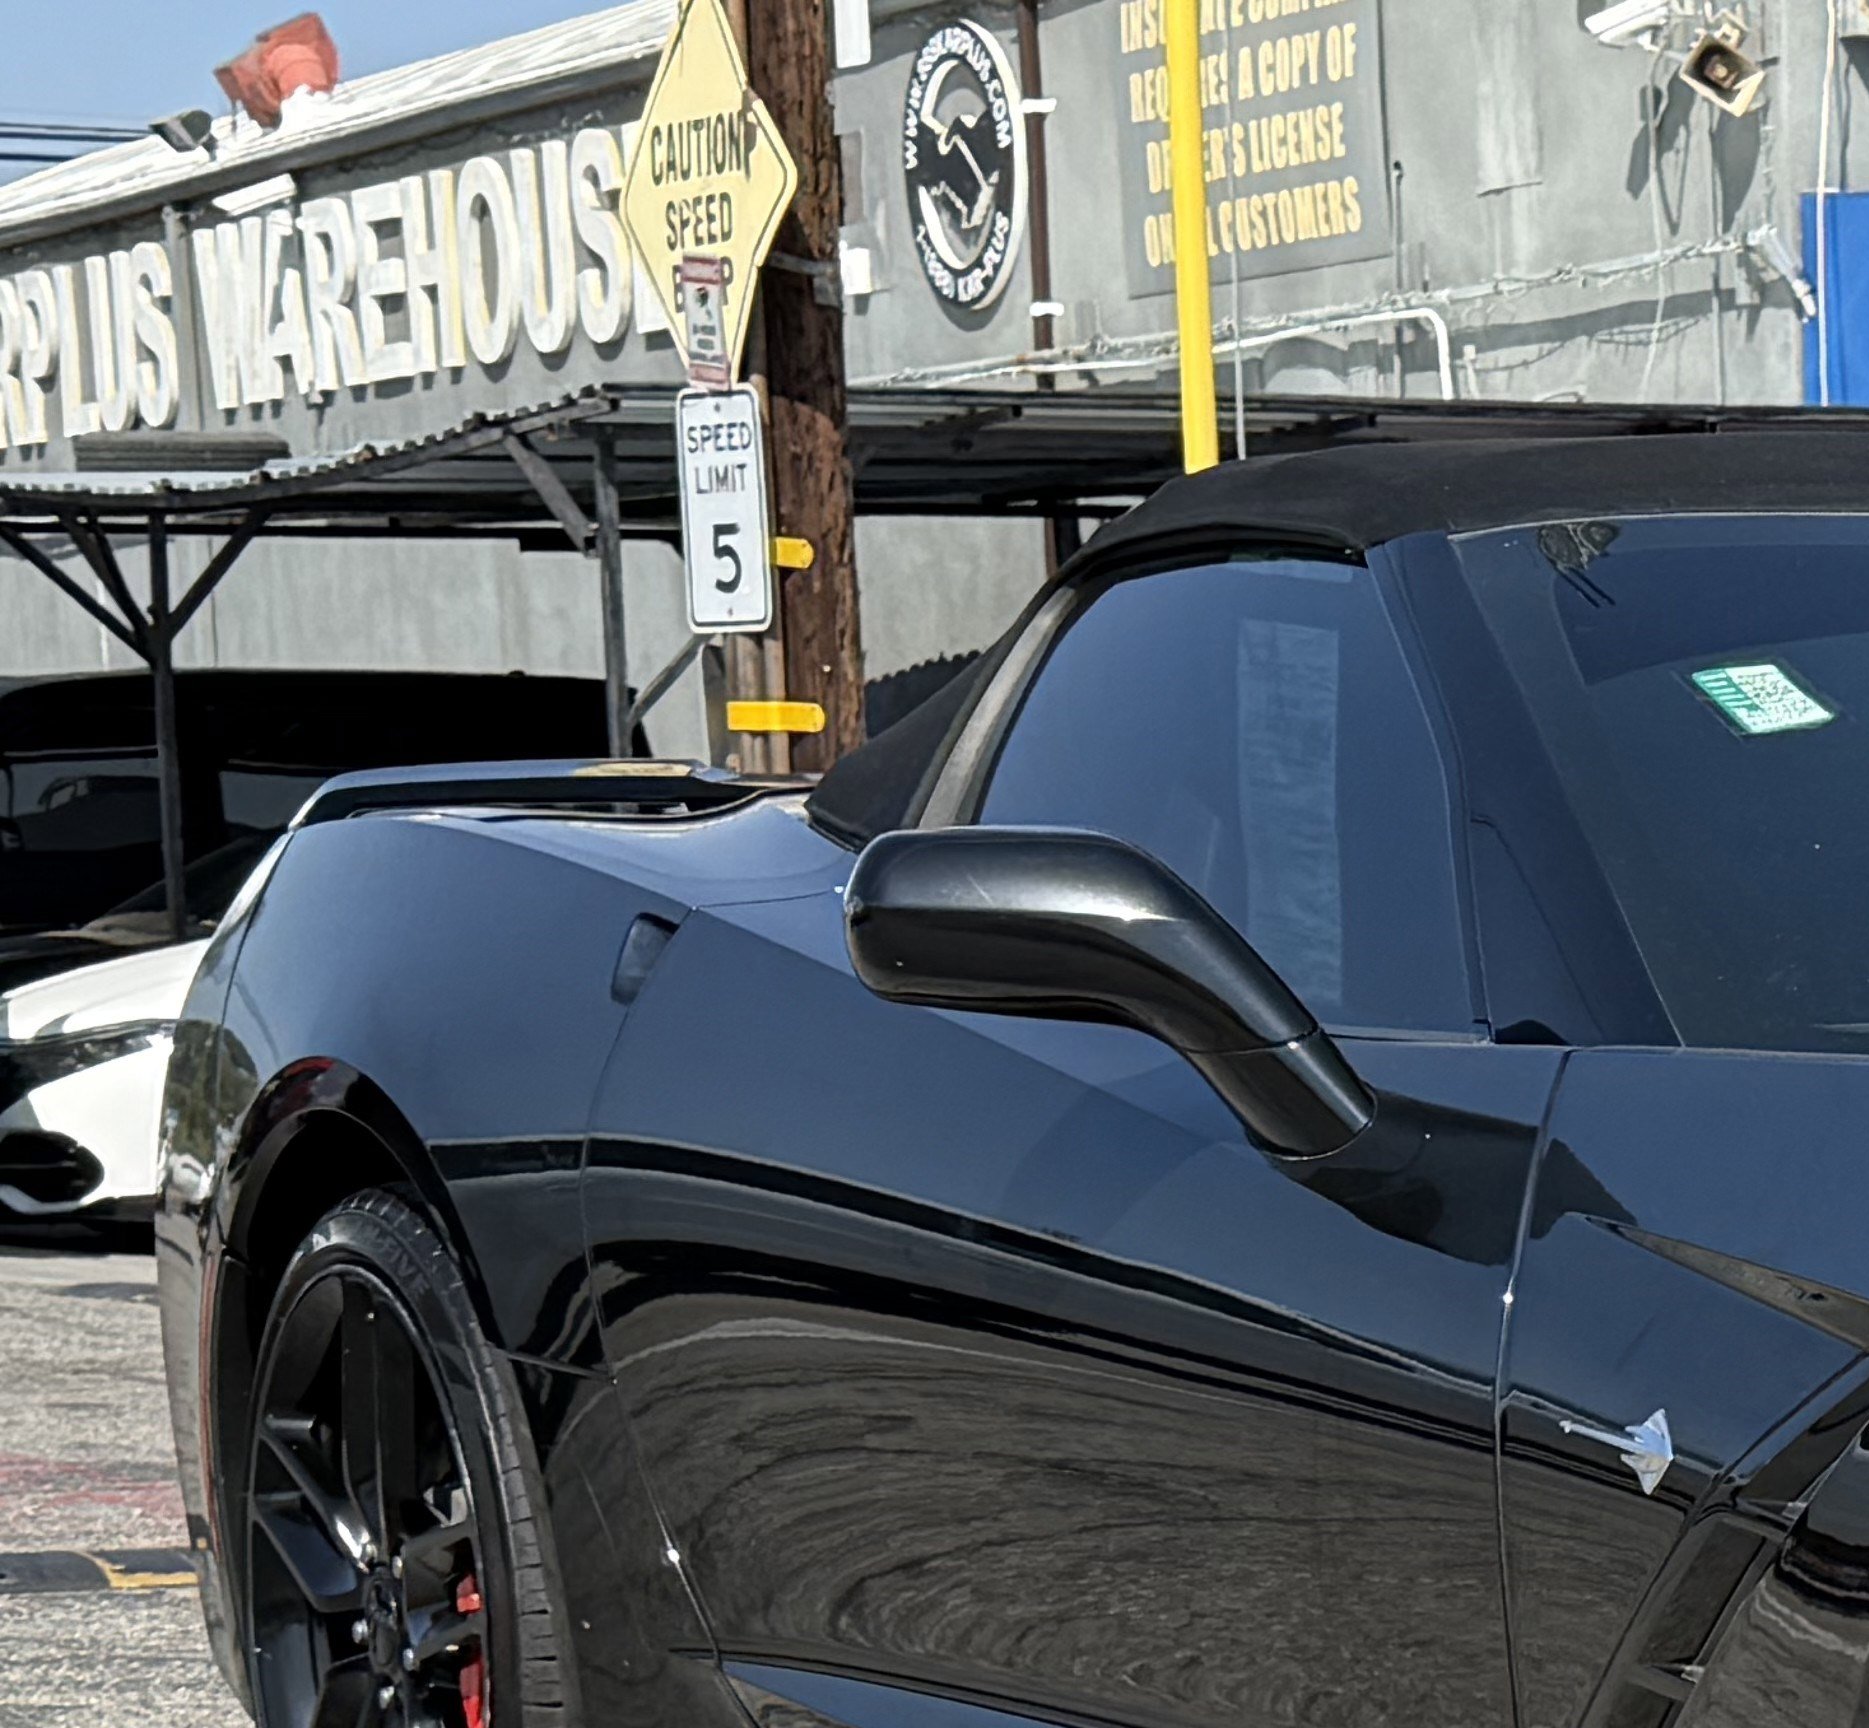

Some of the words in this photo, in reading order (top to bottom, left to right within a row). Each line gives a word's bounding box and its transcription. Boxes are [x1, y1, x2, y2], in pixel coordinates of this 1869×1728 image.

[1238, 46, 1255, 100] A
[1258, 30, 1321, 97] COPY
[1327, 22, 1358, 82] OF
[651, 111, 743, 186] CAUTION
[1249, 101, 1346, 174] LICENSE
[665, 192, 733, 252] SPEED
[1219, 175, 1362, 254] CUSTOMERS
[672, 256, 733, 313] BP
[687, 422, 751, 453] SPEED
[695, 463, 747, 495] LIMIT
[712, 522, 742, 594] 5
